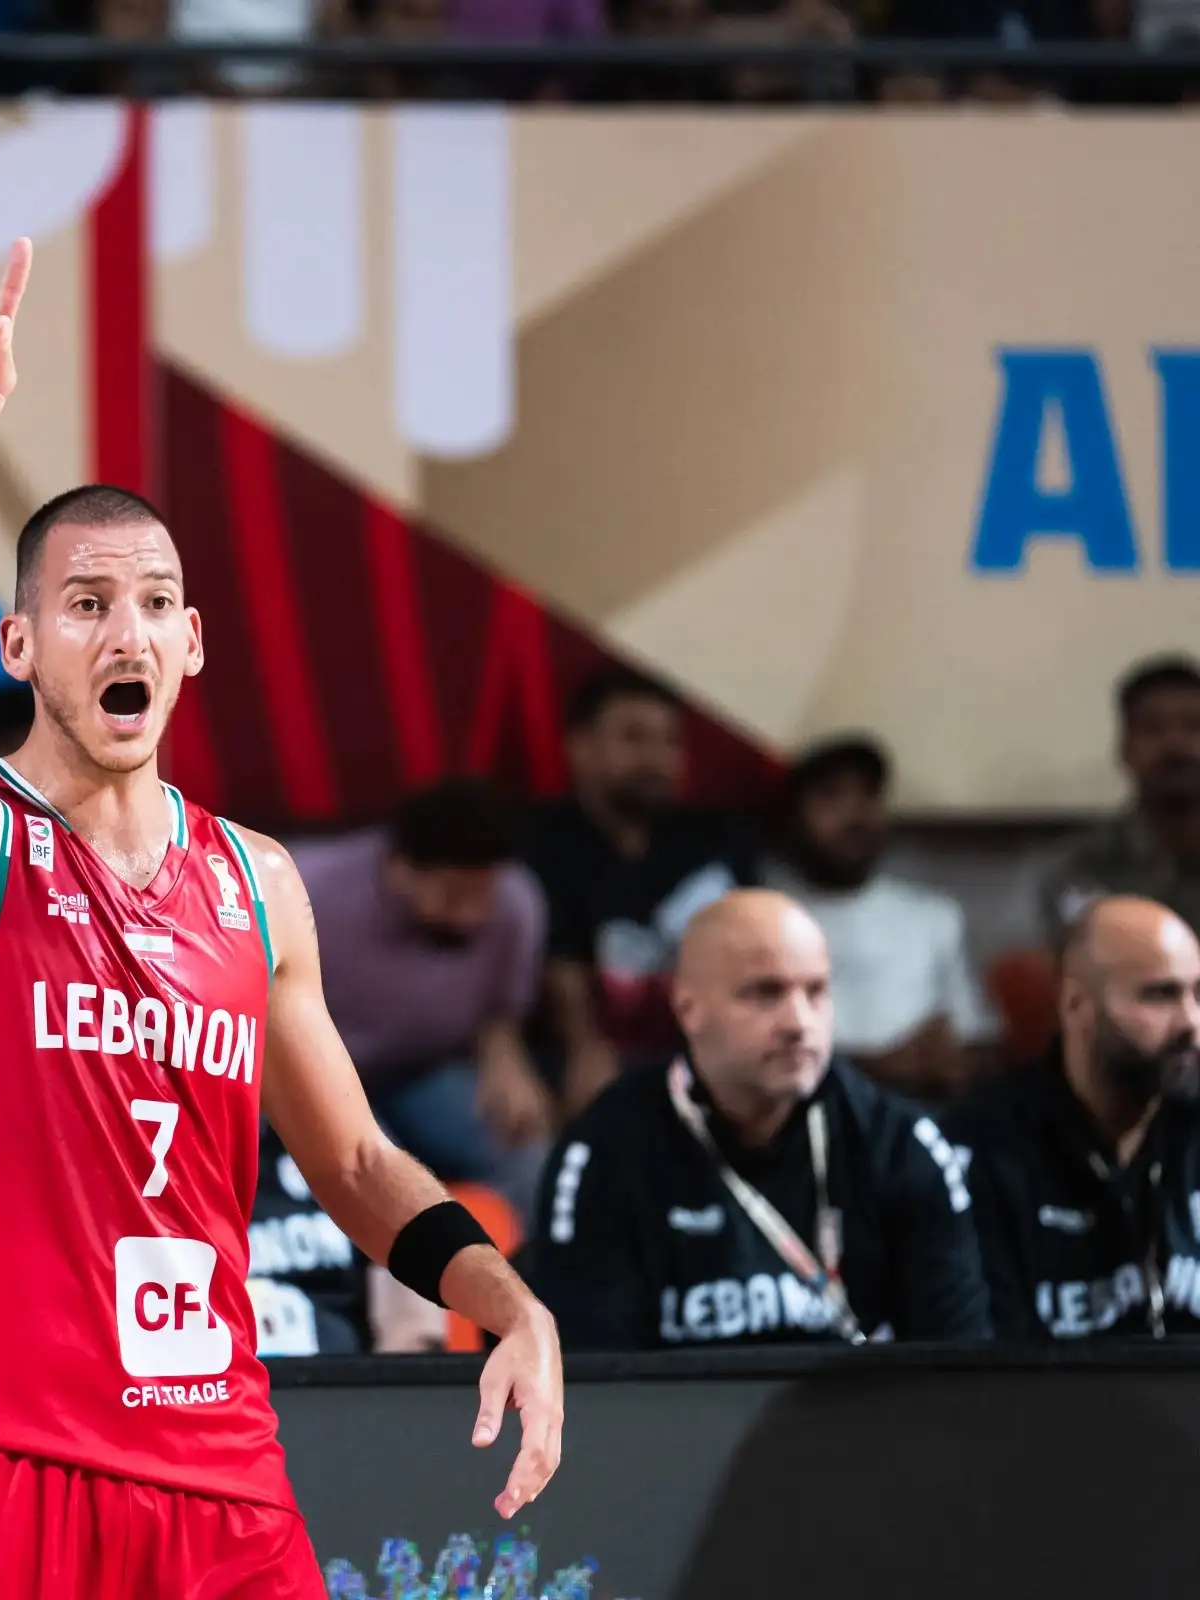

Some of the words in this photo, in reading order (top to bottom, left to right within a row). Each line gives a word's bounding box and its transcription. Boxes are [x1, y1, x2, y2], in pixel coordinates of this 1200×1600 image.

[33, 981, 257, 1084] LEBANON
[130, 1098, 179, 1197] 7
[121, 1380, 230, 1408] CFI.TRADE
